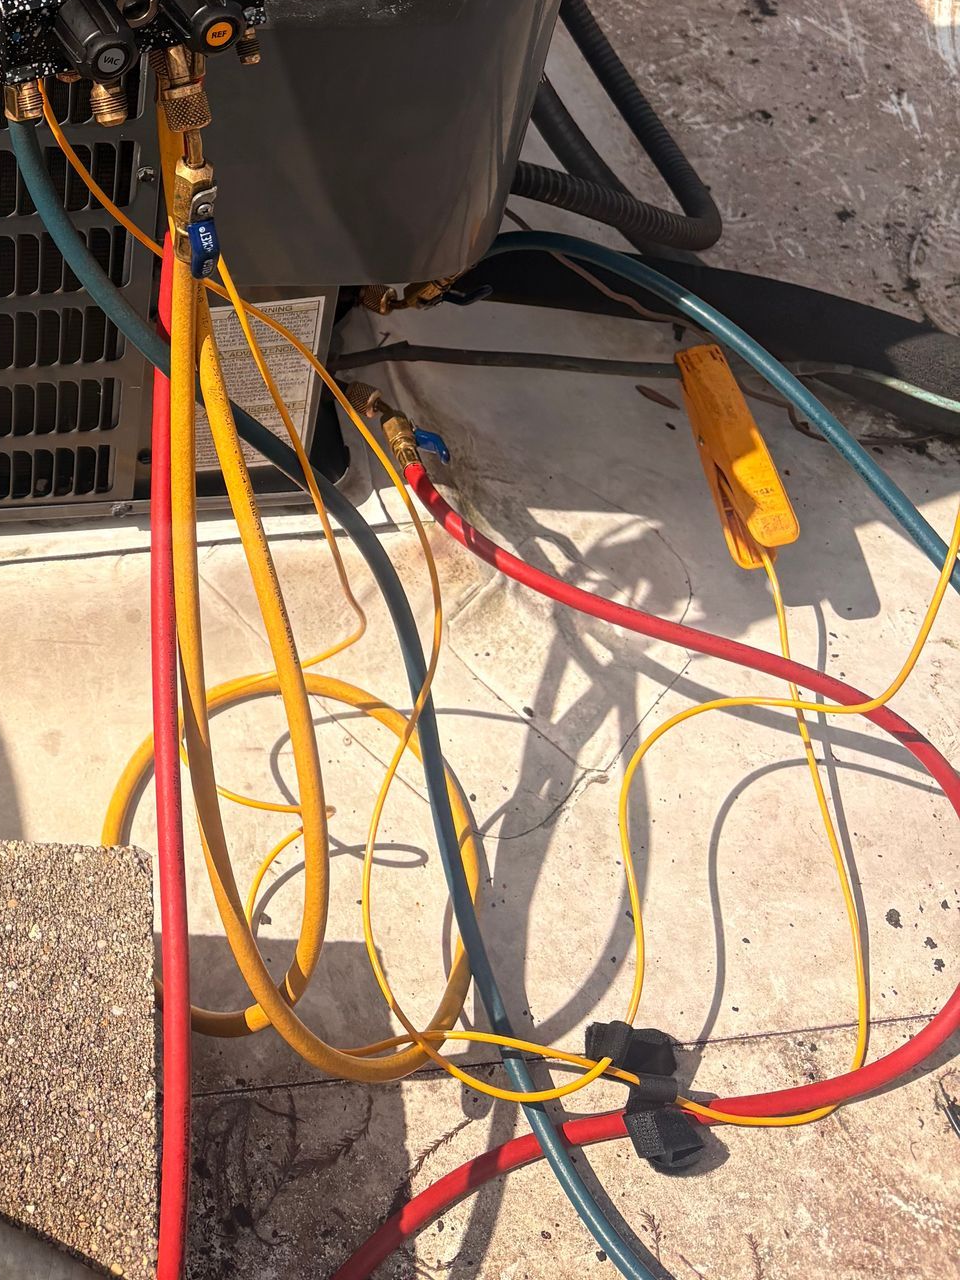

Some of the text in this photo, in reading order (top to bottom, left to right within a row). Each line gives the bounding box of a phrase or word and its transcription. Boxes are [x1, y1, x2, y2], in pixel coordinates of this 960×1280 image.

[210, 30, 228, 40] REF
[103, 55, 121, 66] VAC
[260, 304, 294, 314] RNING
